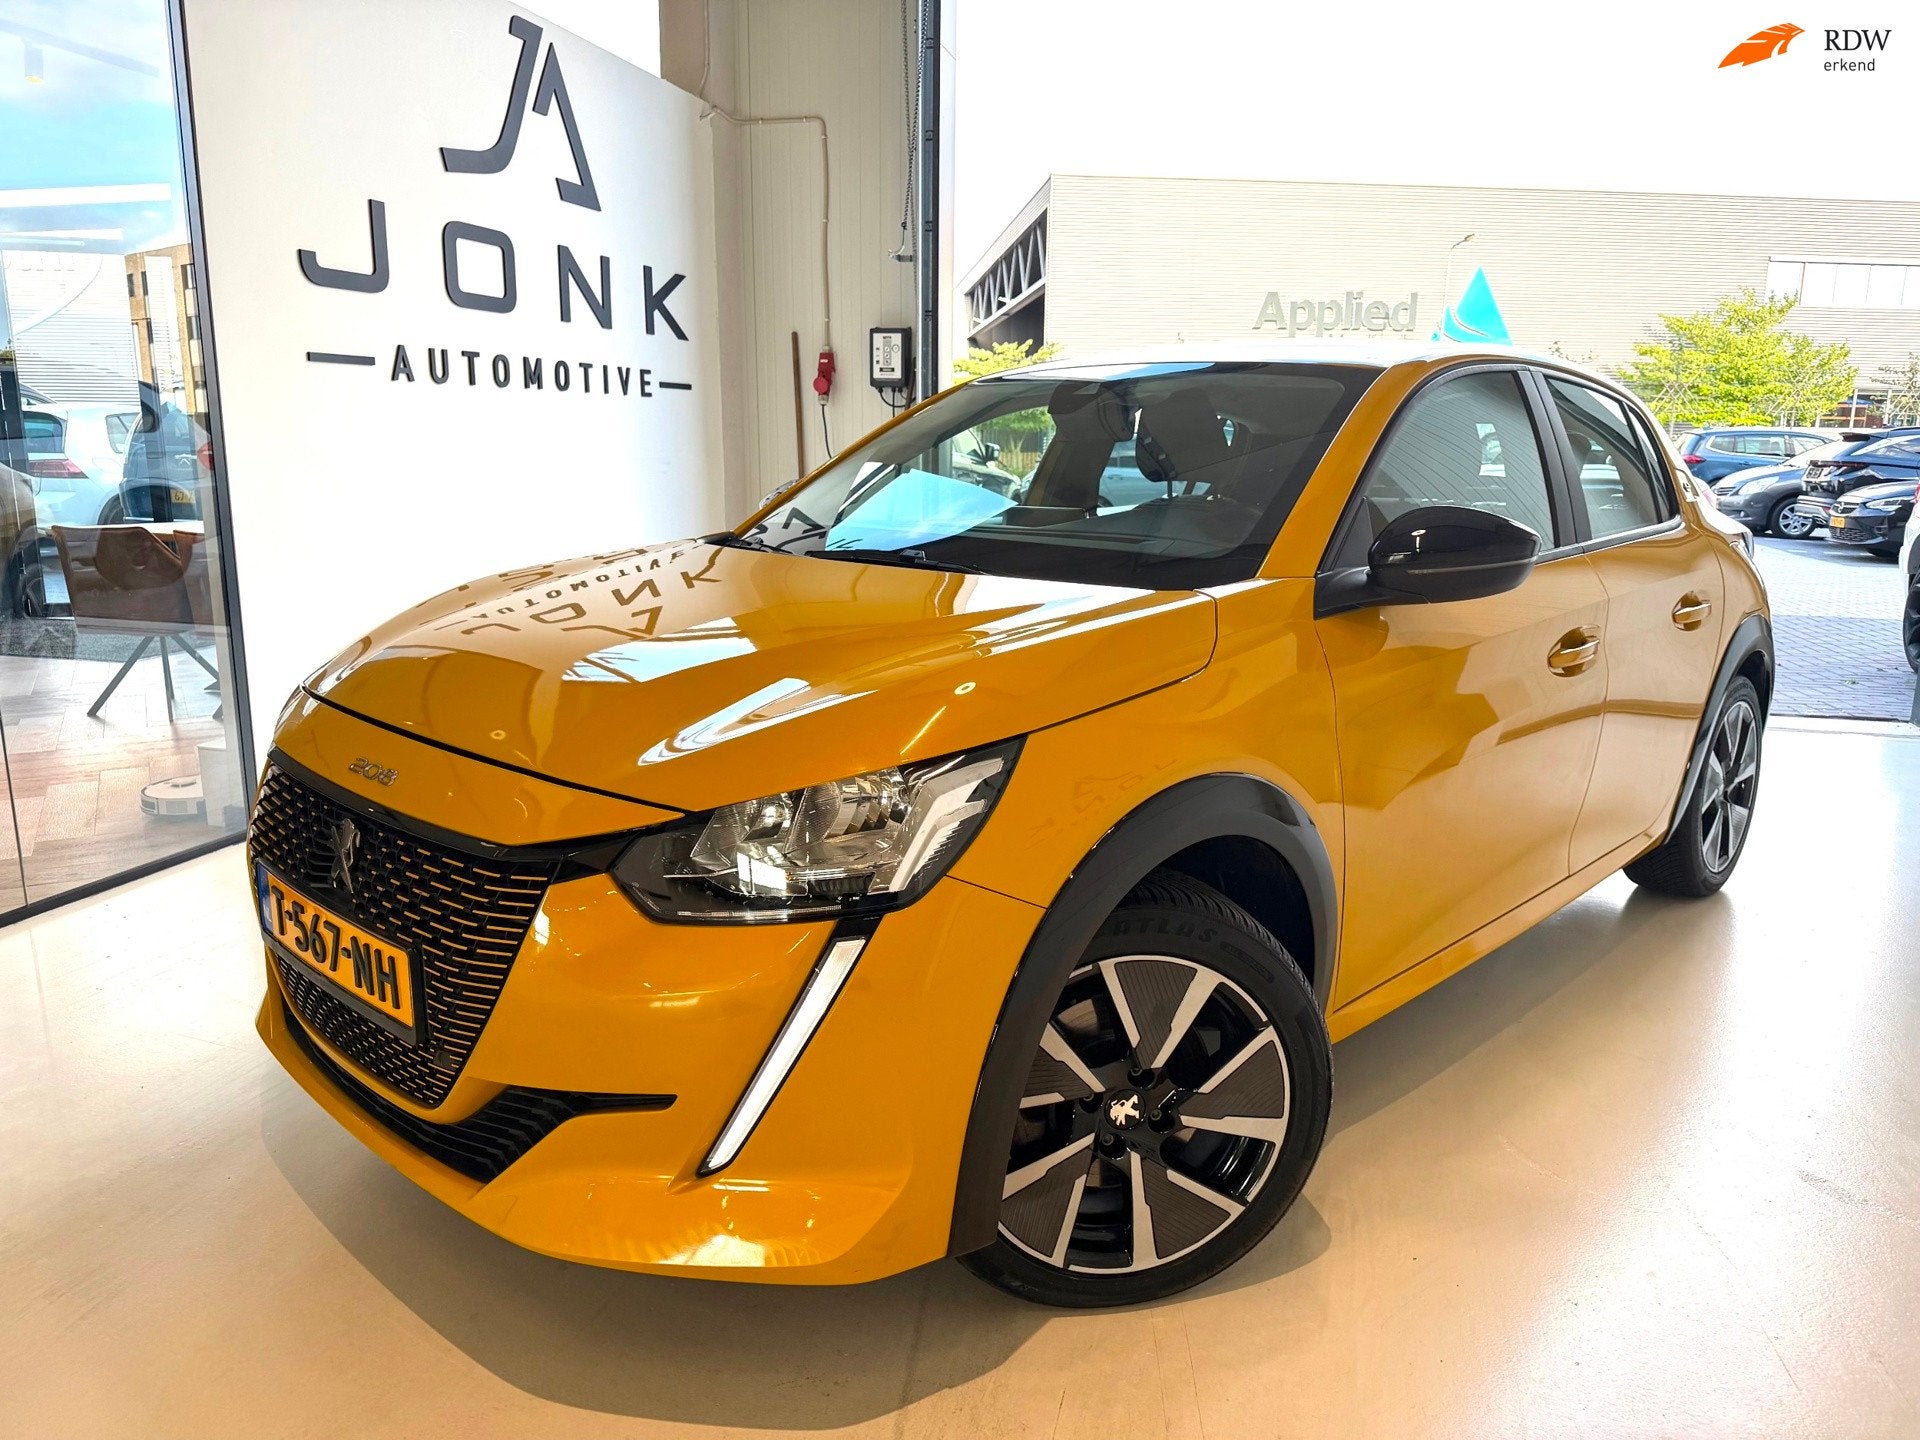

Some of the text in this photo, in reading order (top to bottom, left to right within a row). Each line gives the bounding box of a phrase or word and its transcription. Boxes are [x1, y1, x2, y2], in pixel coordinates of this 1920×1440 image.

[297, 199, 689, 341] JONK
[1252, 291, 1418, 338] Applied
[391, 345, 653, 398] AUTOMOTIVE
[349, 757, 399, 787] 208
[271, 885, 401, 1010] T-567-NH
